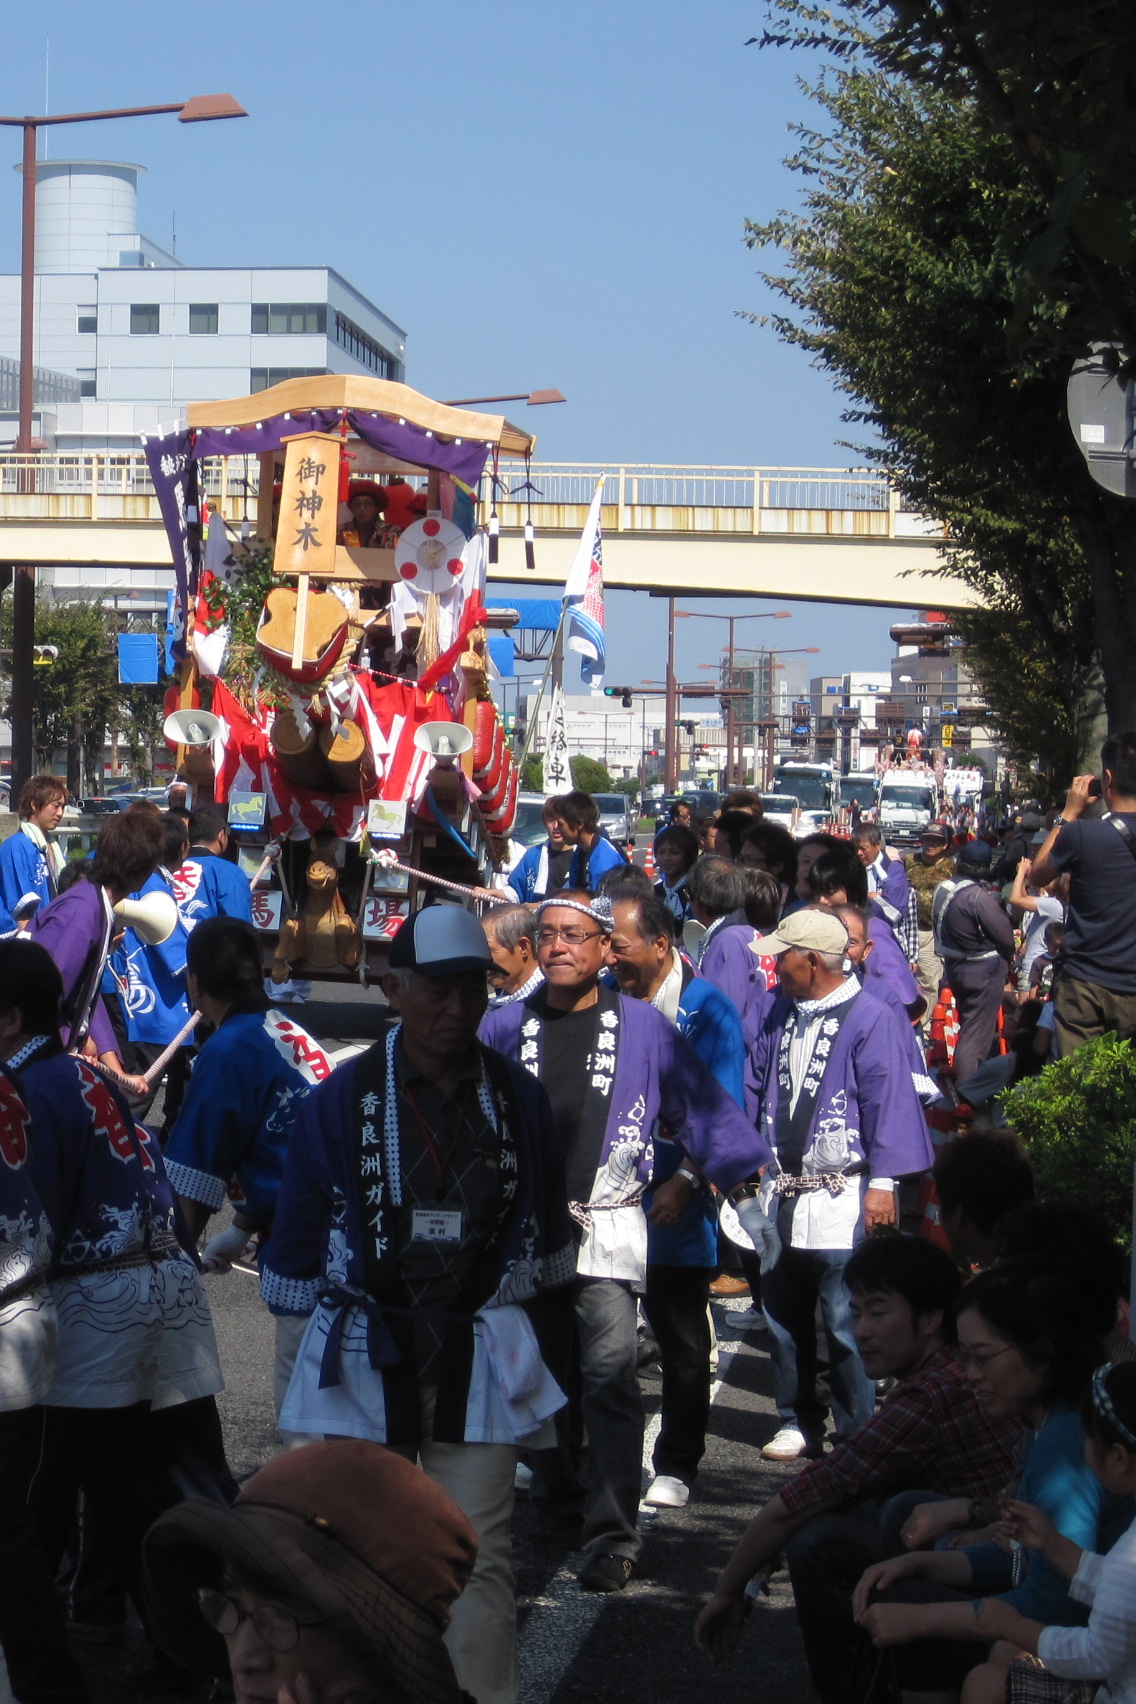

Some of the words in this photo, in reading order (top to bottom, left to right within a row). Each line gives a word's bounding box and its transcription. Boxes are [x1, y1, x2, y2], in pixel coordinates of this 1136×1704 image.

[291, 456, 327, 552] 御神木
[592, 1010, 619, 1096] 香良洲町
[803, 1018, 840, 1098] 香良洲町
[359, 1091, 389, 1260] 香良洲ガイド
